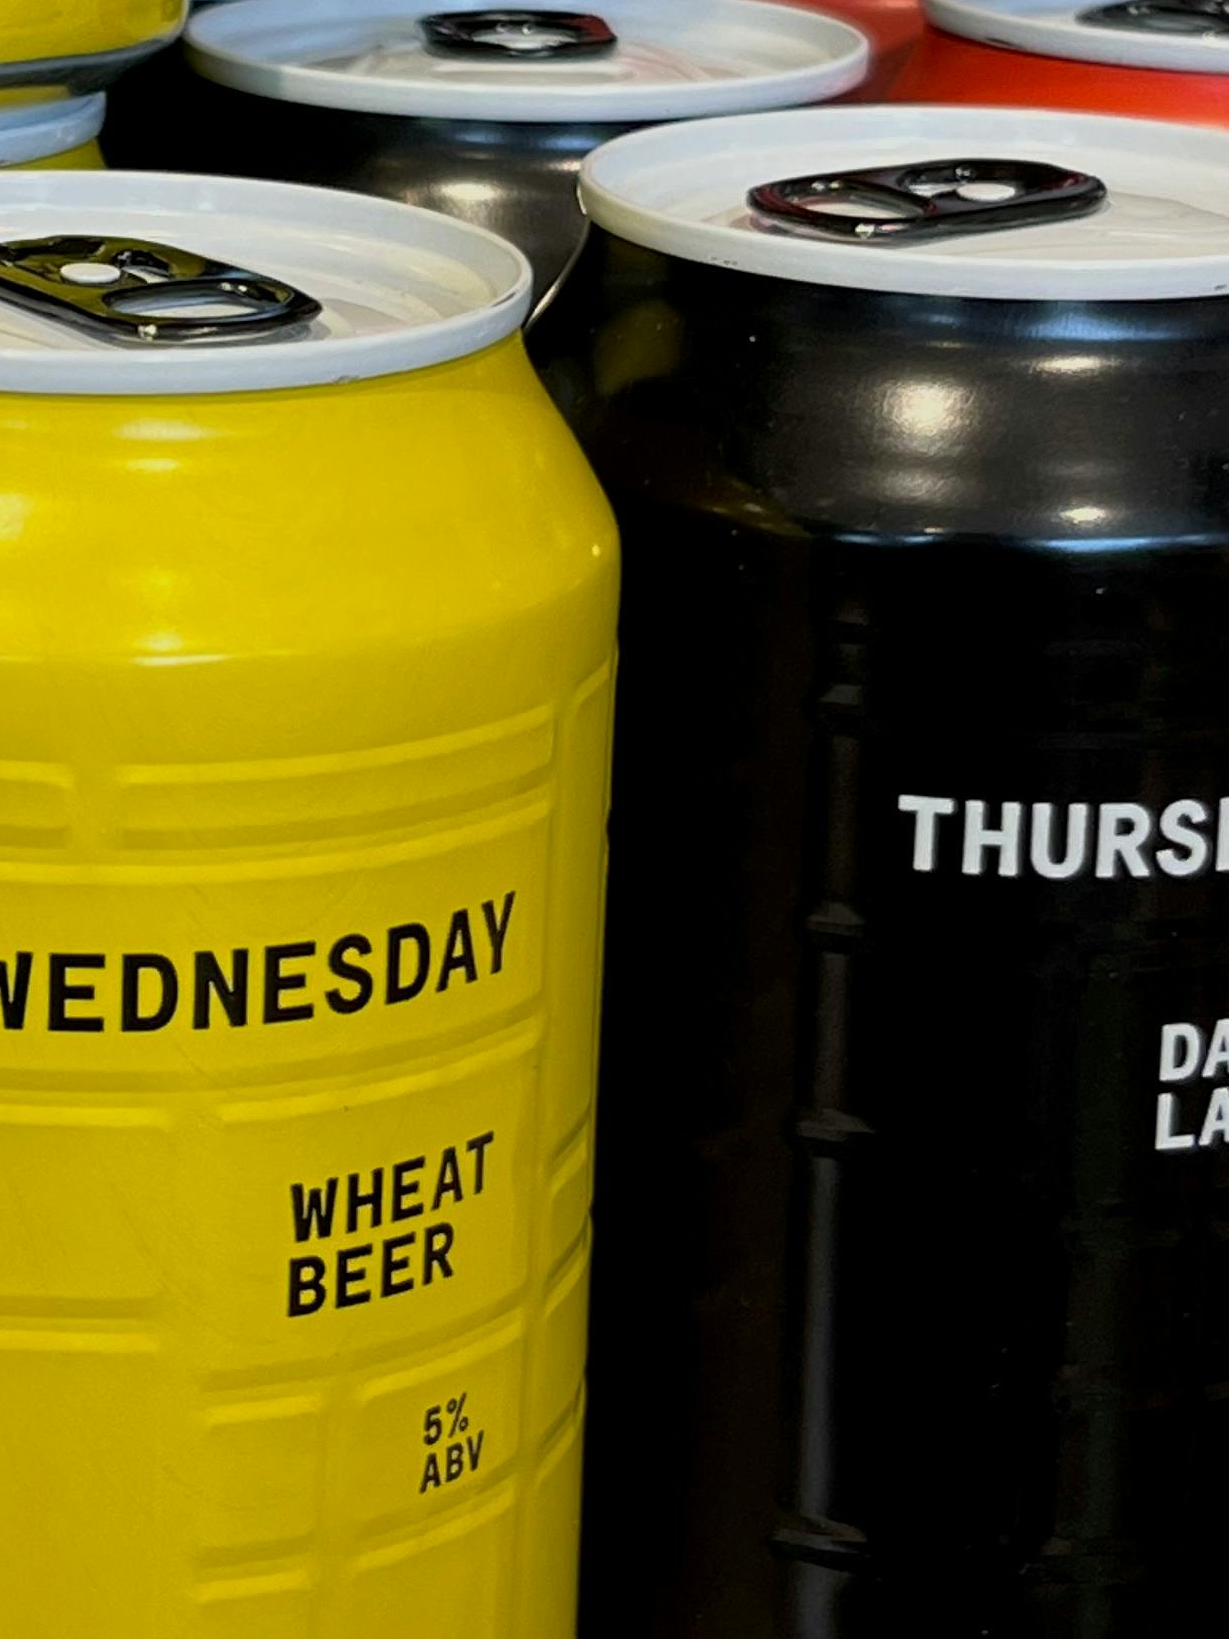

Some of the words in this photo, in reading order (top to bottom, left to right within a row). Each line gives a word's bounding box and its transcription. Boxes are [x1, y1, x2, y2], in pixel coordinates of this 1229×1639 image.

[897, 794, 1229, 879] THURS
[290, 1131, 494, 1243] WHEAT
[286, 1223, 455, 1318] BEER
[422, 1391, 470, 1446] 5%
[419, 1432, 484, 1494] ABV
